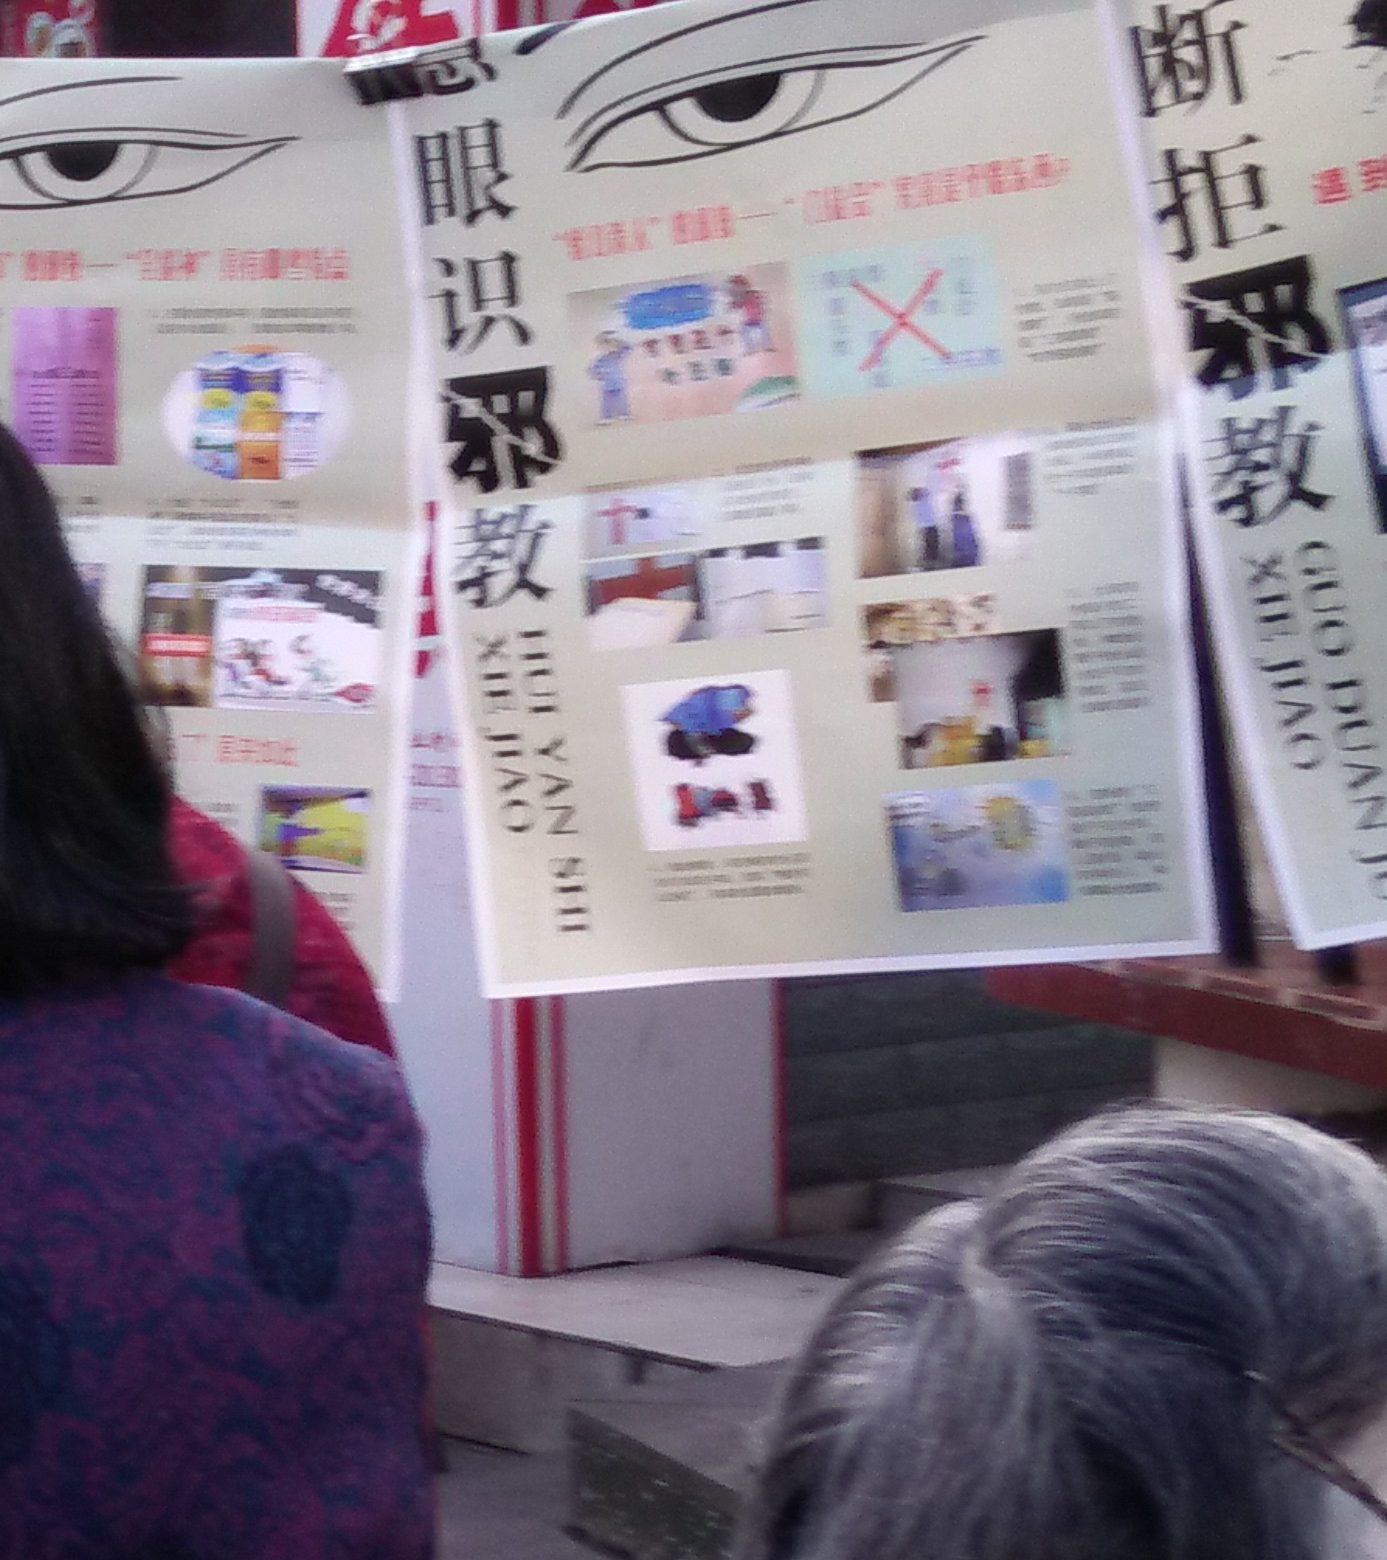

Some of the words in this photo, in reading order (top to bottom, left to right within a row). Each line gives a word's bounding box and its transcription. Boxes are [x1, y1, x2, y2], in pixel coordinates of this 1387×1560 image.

[1239, 554, 1300, 643] XIE
[1295, 541, 1354, 656] GUO
[476, 632, 519, 714] XIE
[518, 629, 559, 713] HUI
[1249, 657, 1324, 771] JIAO
[477, 726, 536, 834] JIAO
[535, 737, 580, 834] YAN
[549, 857, 591, 933] SHI
